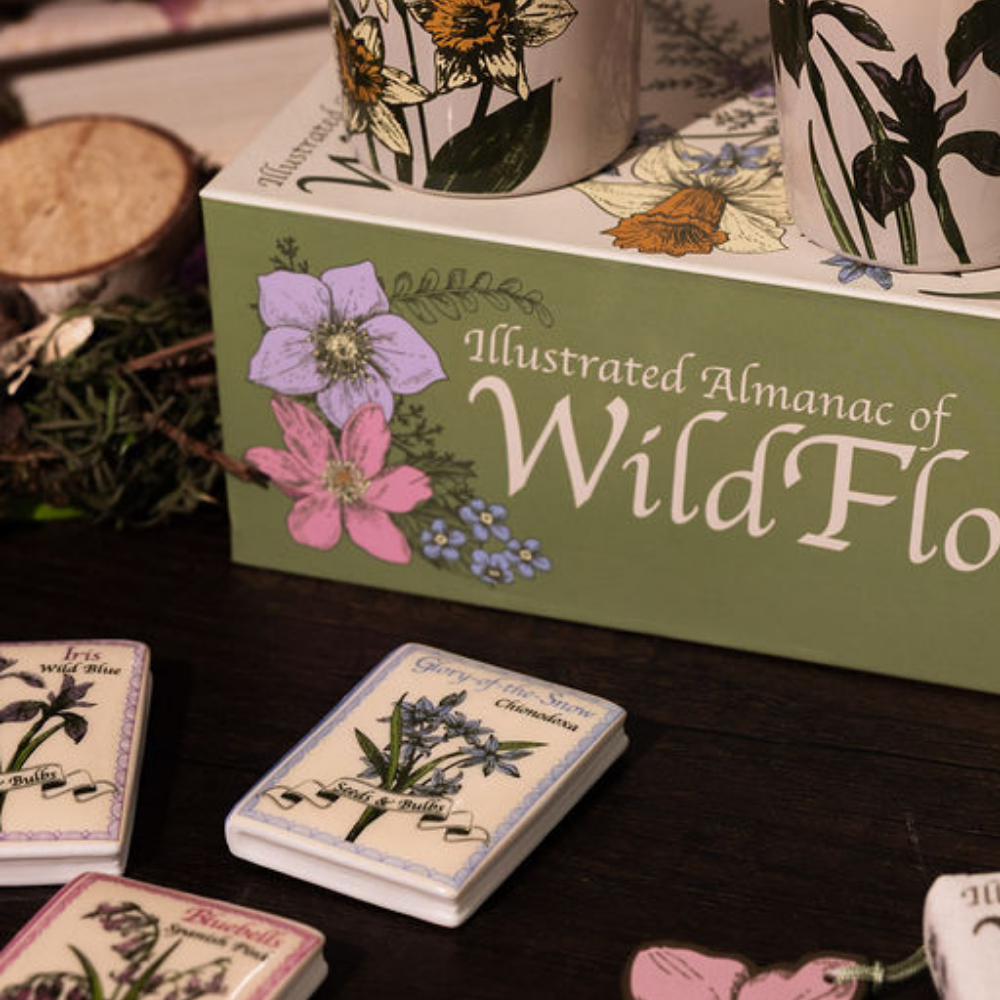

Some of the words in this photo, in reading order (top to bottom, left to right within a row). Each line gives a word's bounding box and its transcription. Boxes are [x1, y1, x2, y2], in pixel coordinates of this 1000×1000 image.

[257, 103, 344, 188] Illustrated
[463, 323, 696, 394] Illustrated
[702, 362, 894, 426] Almanac
[909, 392, 959, 452] of
[64, 646, 102, 662] Iris
[40, 663, 79, 674] Wild
[83, 663, 122, 675] Blue
[495, 697, 579, 733] Chionodoxa
[9, 768, 58, 787] Bulbs
[399, 798, 445, 813] Bulbs
[182, 905, 286, 949] Bluebells
